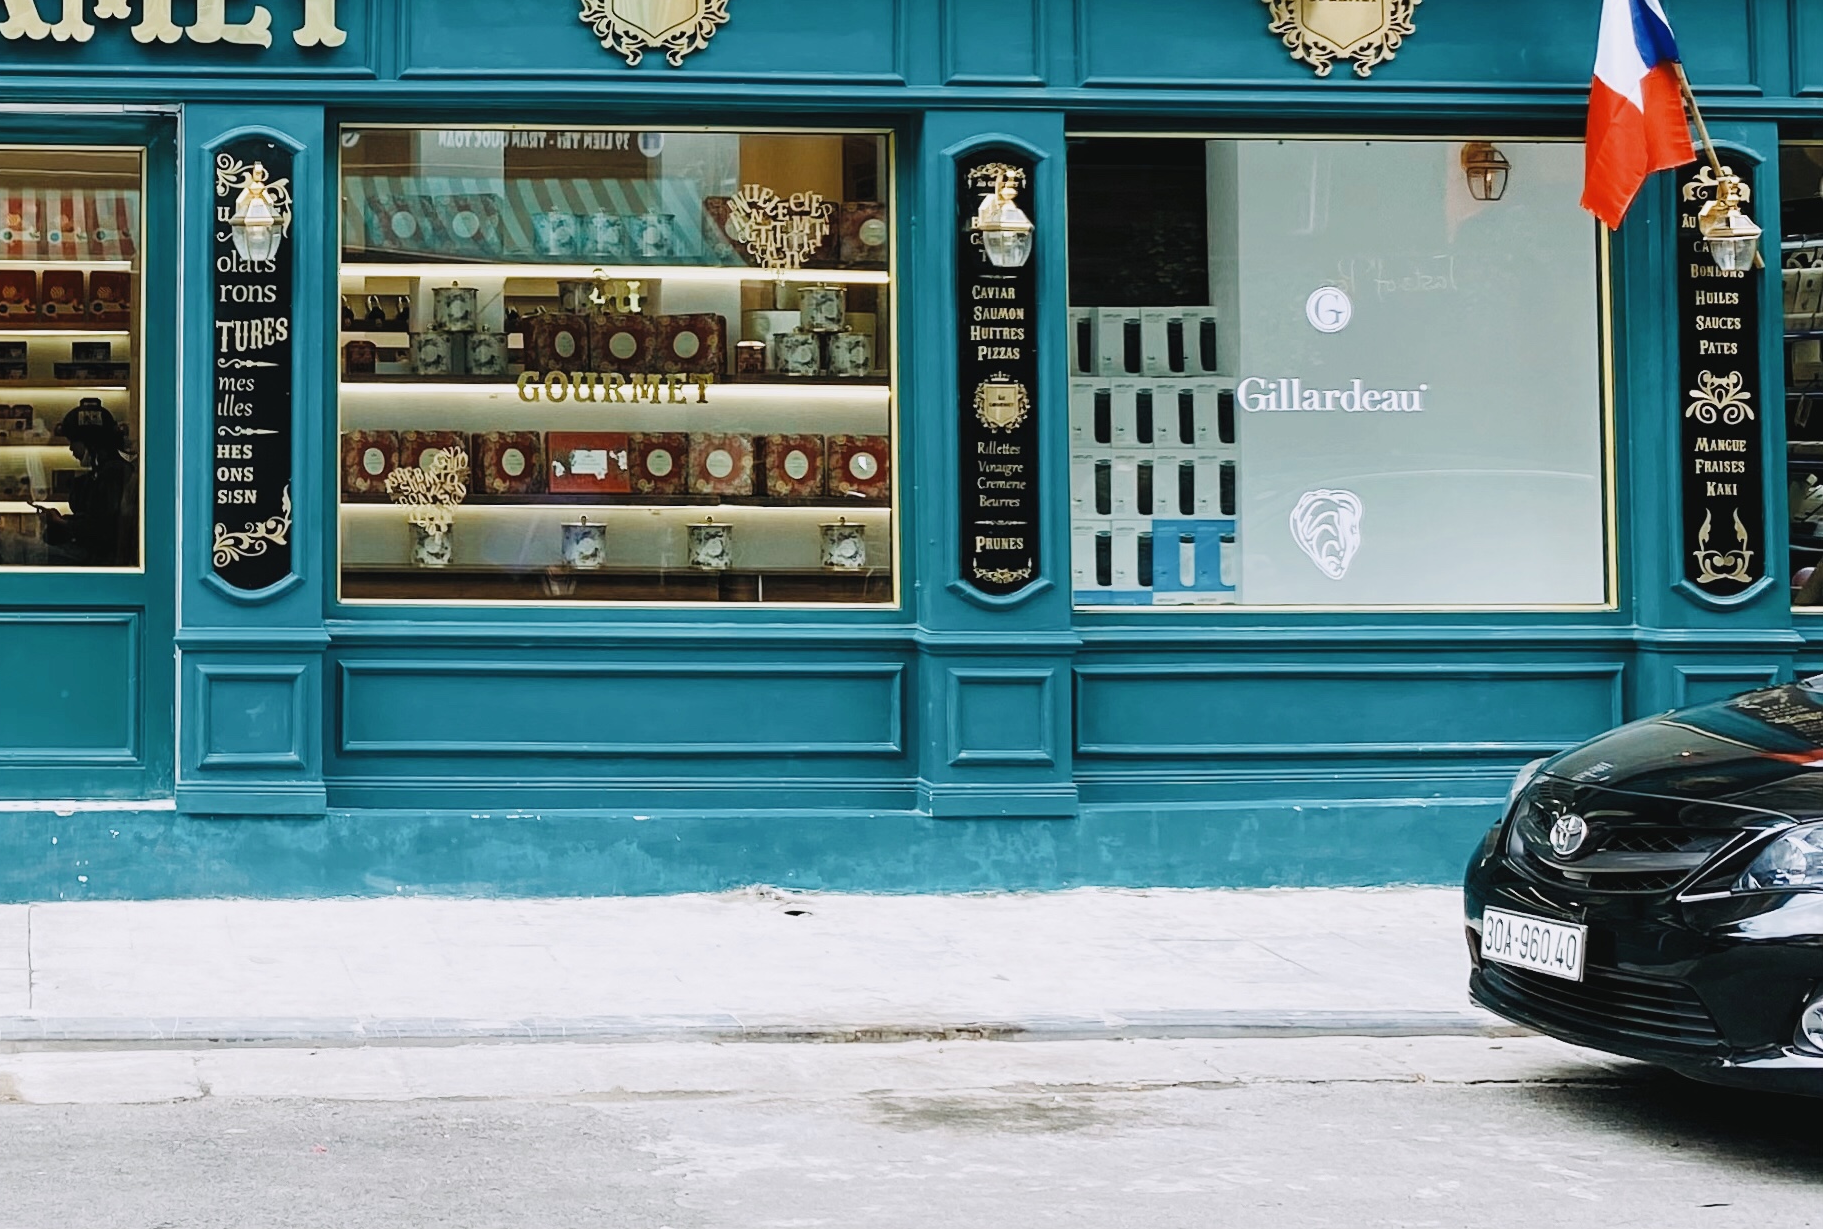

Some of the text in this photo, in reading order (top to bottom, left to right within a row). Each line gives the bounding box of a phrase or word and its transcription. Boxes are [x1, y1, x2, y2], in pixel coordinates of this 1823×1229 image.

[219, 284, 277, 303] rons
[972, 285, 1016, 300] CAVIAR
[1695, 290, 1739, 305] HUILES
[973, 305, 1025, 321] SAUMON
[1315, 293, 1345, 326] G
[1695, 315, 1741, 330] SAUCES
[216, 317, 288, 353] TURES
[970, 325, 1026, 341] HUITRES
[977, 345, 1020, 361] PIZZAS
[1699, 339, 1738, 355] PATES
[218, 376, 255, 391] mes
[516, 370, 714, 404] GOURMET
[1237, 377, 1423, 413] Gillardeau
[216, 444, 253, 459] HES
[977, 441, 1021, 455] Rillettes
[1694, 437, 1747, 452] MANGUE
[977, 461, 1024, 476] Vinaigre
[1695, 459, 1746, 474] FRAISES
[216, 467, 254, 482] ONS
[1705, 481, 1739, 497] KAKI
[979, 494, 1021, 508] Beurres
[975, 535, 1025, 553] PRUNES
